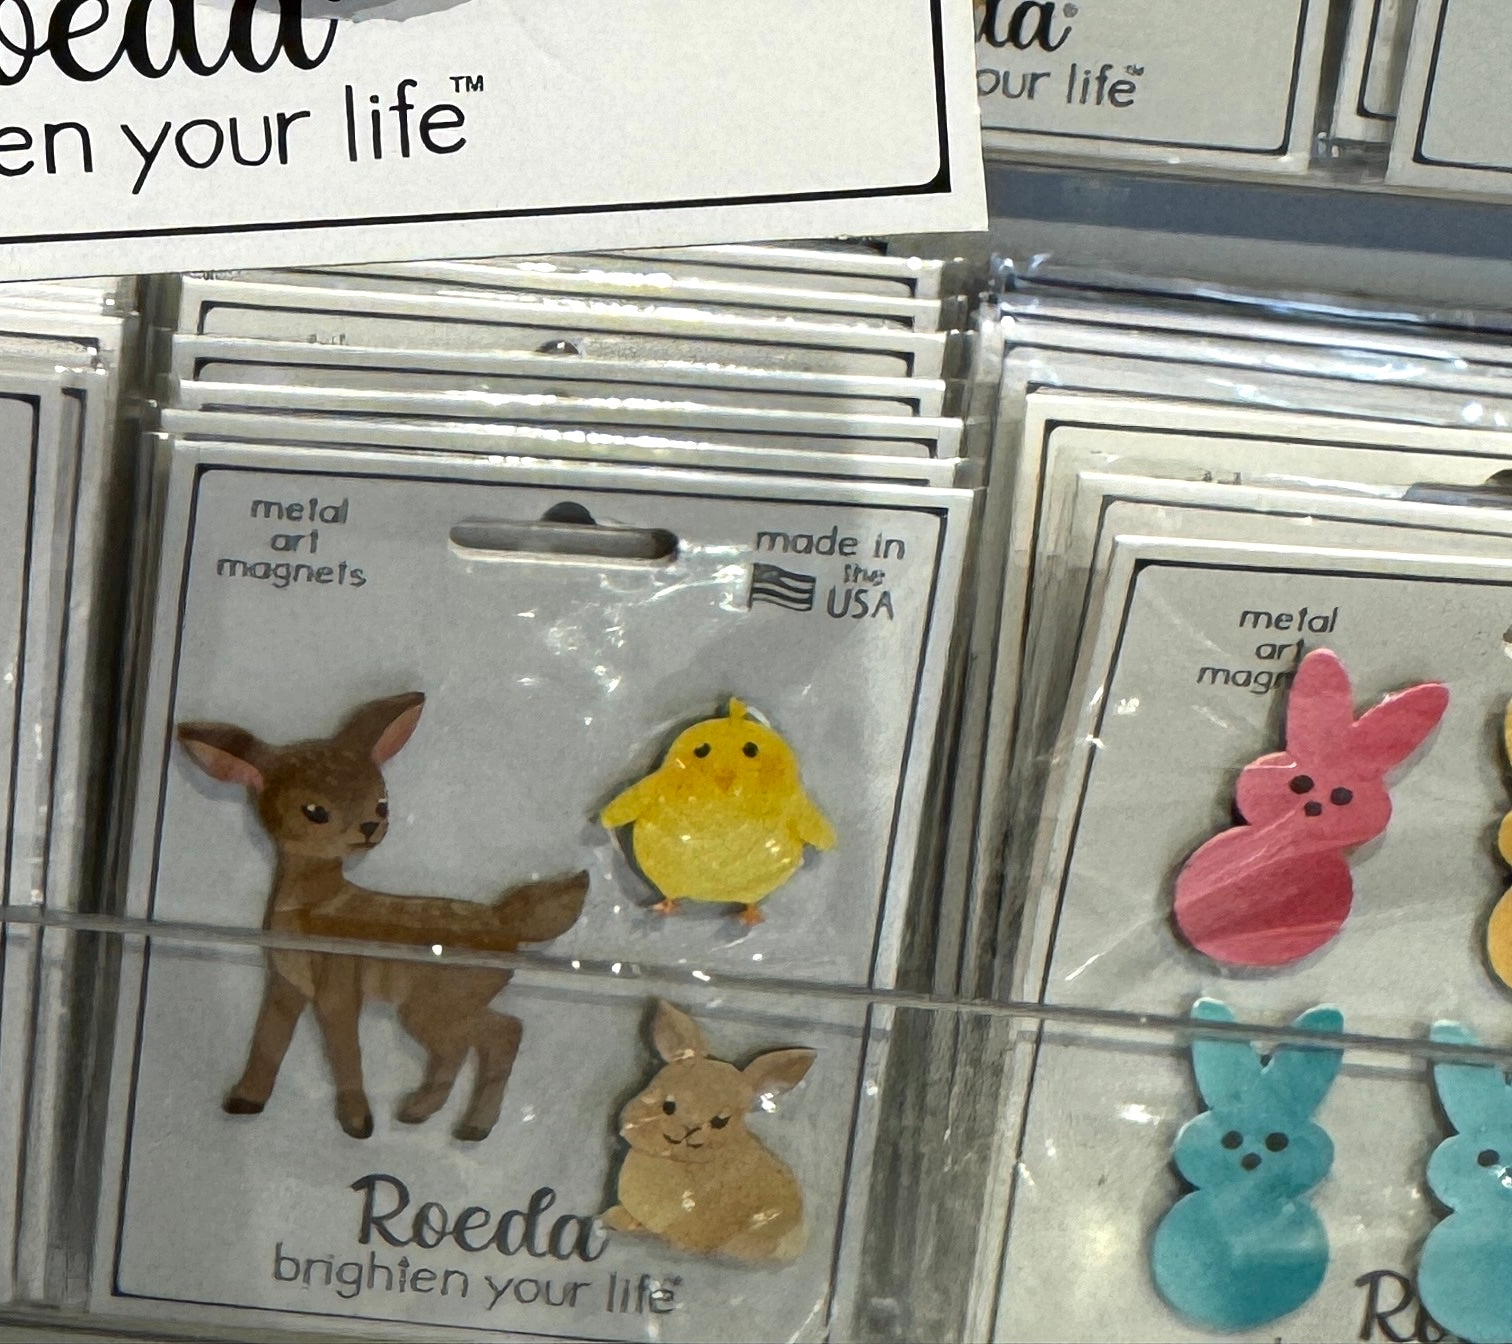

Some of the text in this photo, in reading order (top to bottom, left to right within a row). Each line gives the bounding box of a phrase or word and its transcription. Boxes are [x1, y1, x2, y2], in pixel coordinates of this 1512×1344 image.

[977, 67, 1051, 100] our
[120, 109, 311, 194] your
[250, 497, 349, 525] metal
[270, 528, 319, 554] art
[756, 525, 906, 561] made in
[216, 558, 367, 590] magnets
[826, 584, 895, 622] USA
[1239, 606, 1340, 634] metal
[1255, 638, 1305, 662] art
[273, 1242, 469, 1300] brighten
[484, 1274, 592, 1312] your
